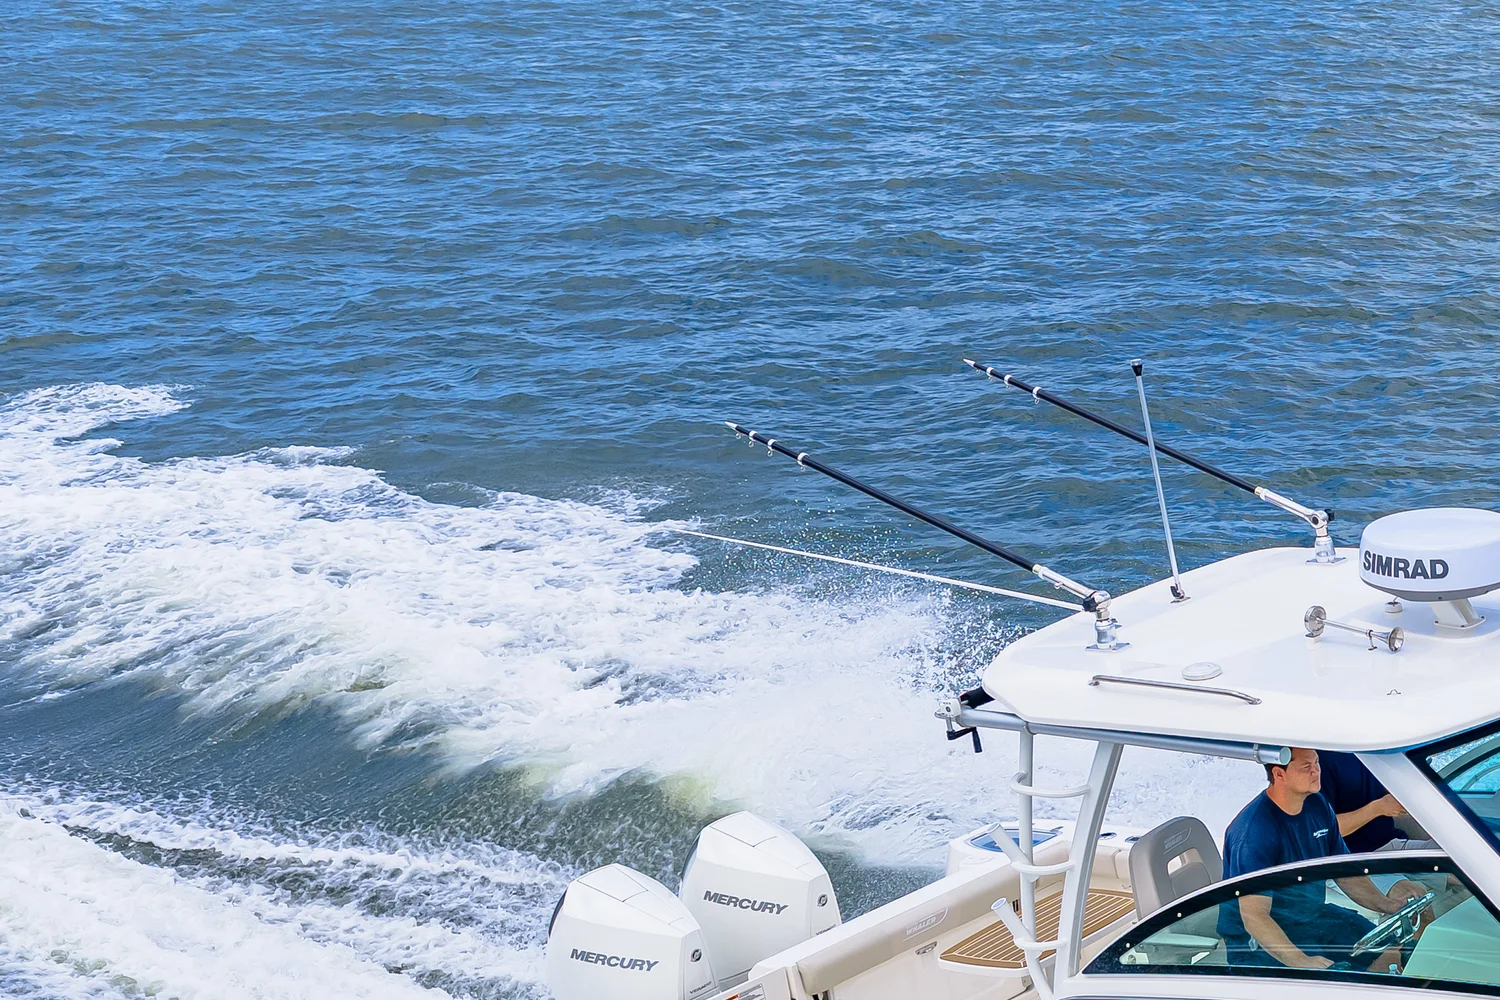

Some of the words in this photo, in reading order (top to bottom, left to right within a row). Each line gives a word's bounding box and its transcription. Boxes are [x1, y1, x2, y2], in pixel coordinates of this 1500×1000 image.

[1363, 550, 1449, 579] SIMRAD
[703, 890, 789, 915] MERCURY
[906, 916, 937, 935] WHALER
[570, 948, 659, 972] MERCURY
